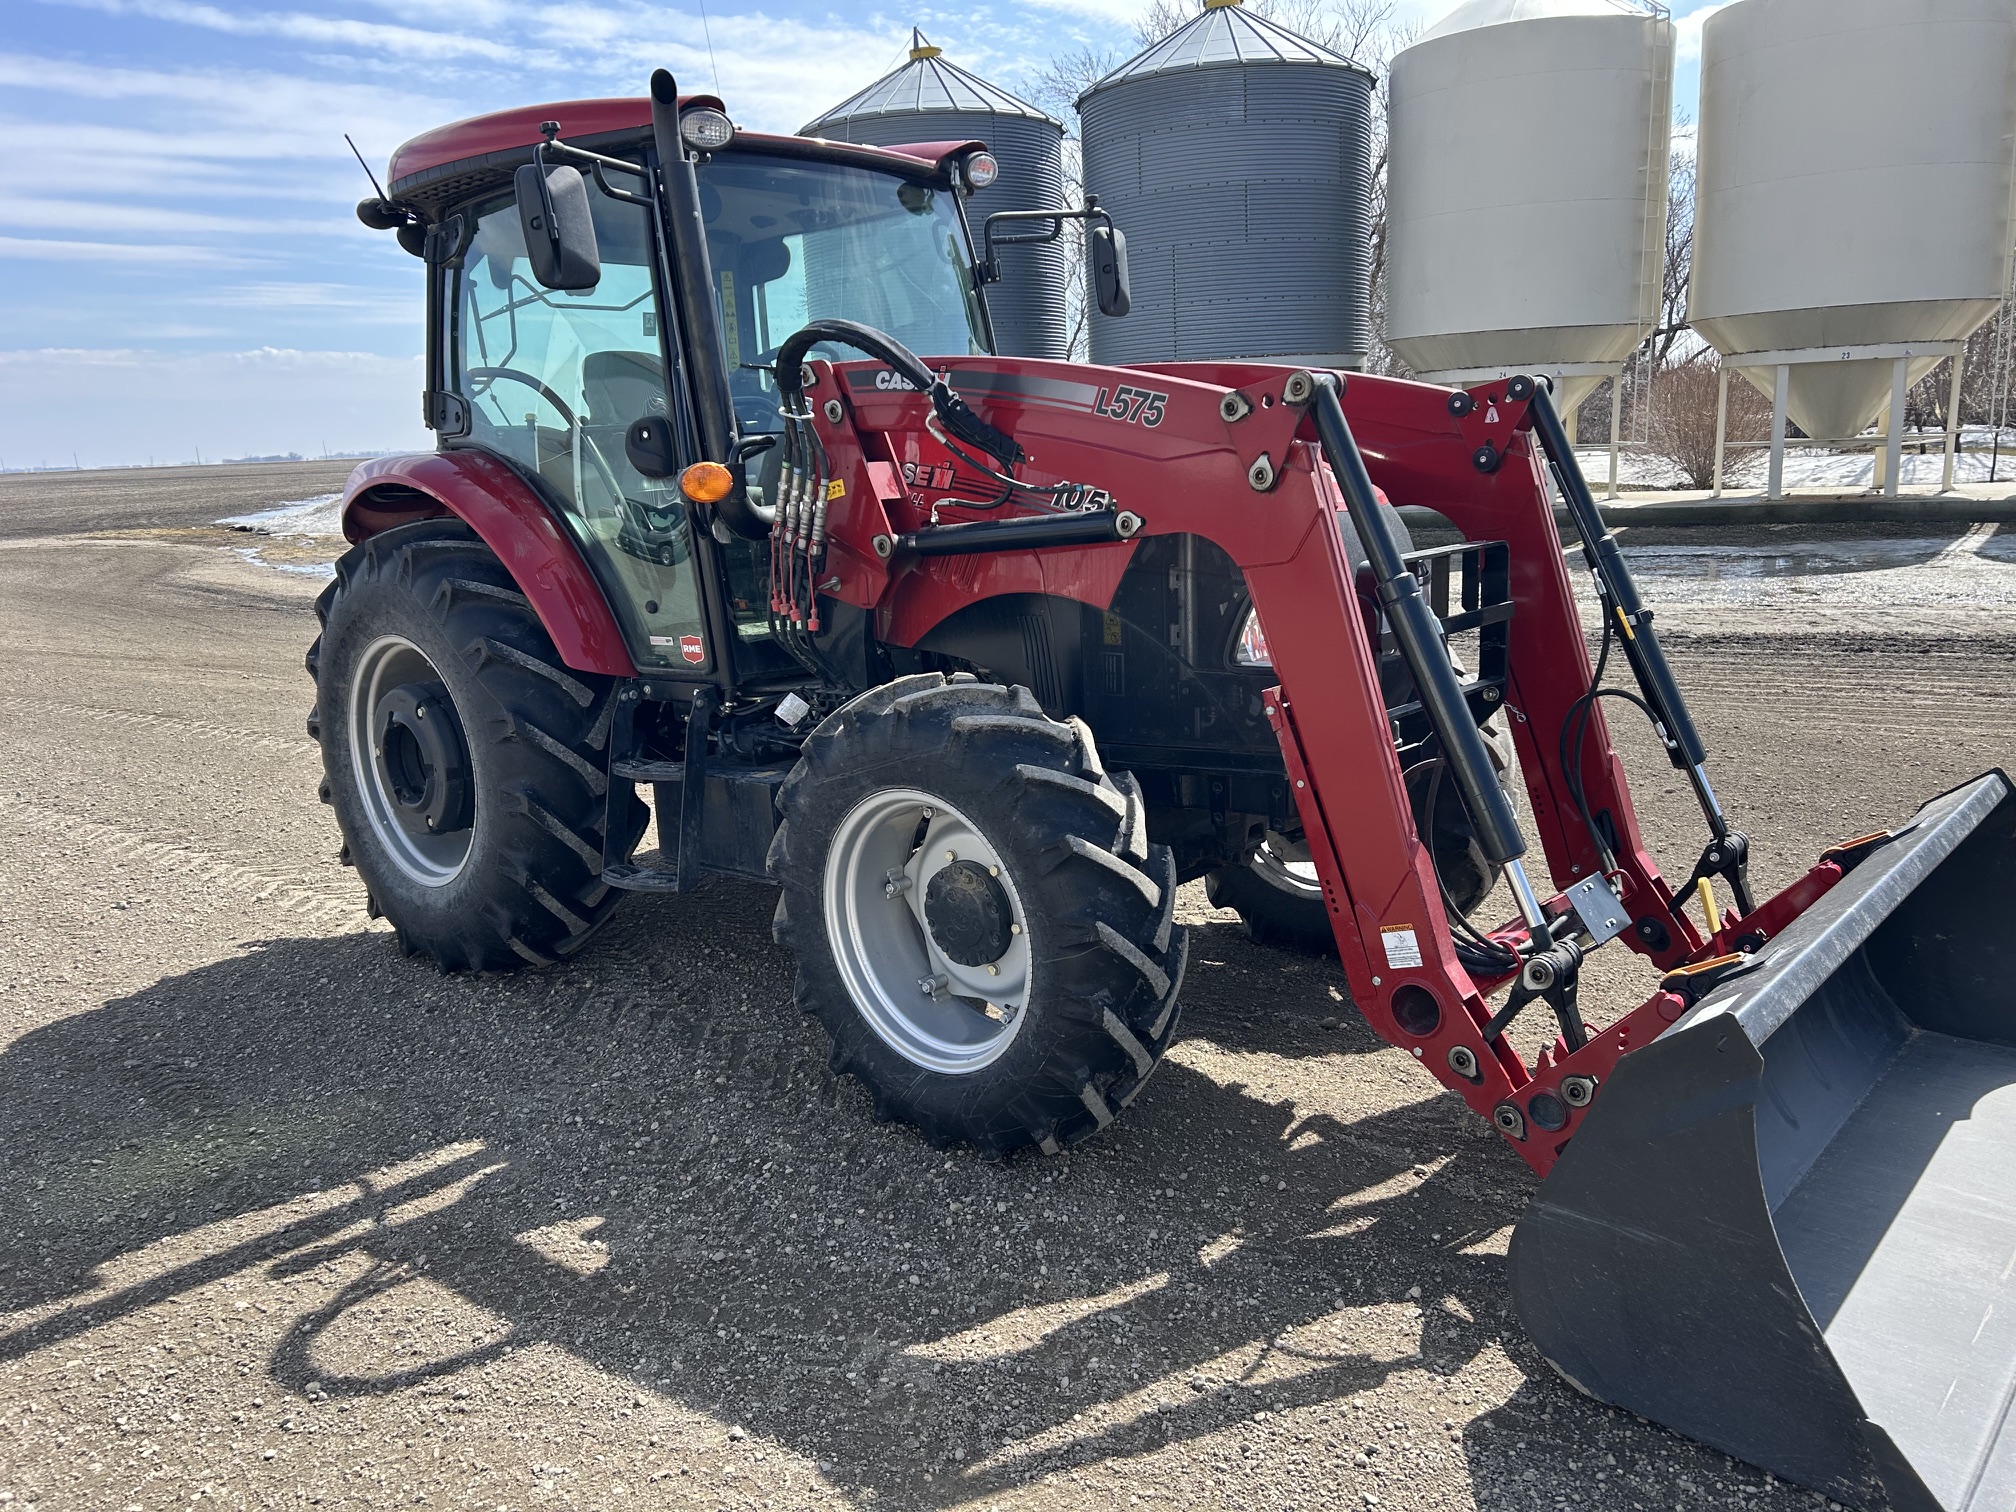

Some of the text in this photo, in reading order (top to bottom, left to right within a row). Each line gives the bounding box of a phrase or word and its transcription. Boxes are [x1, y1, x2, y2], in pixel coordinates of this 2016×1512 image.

[1841, 351, 1851, 360] 23
[875, 370, 919, 390] CAS
[1093, 383, 1170, 429] L575
[901, 462, 932, 487] SE
[1050, 480, 1109, 512] 105
[682, 644, 702, 653] RME
[1385, 924, 1413, 932] WARNING
